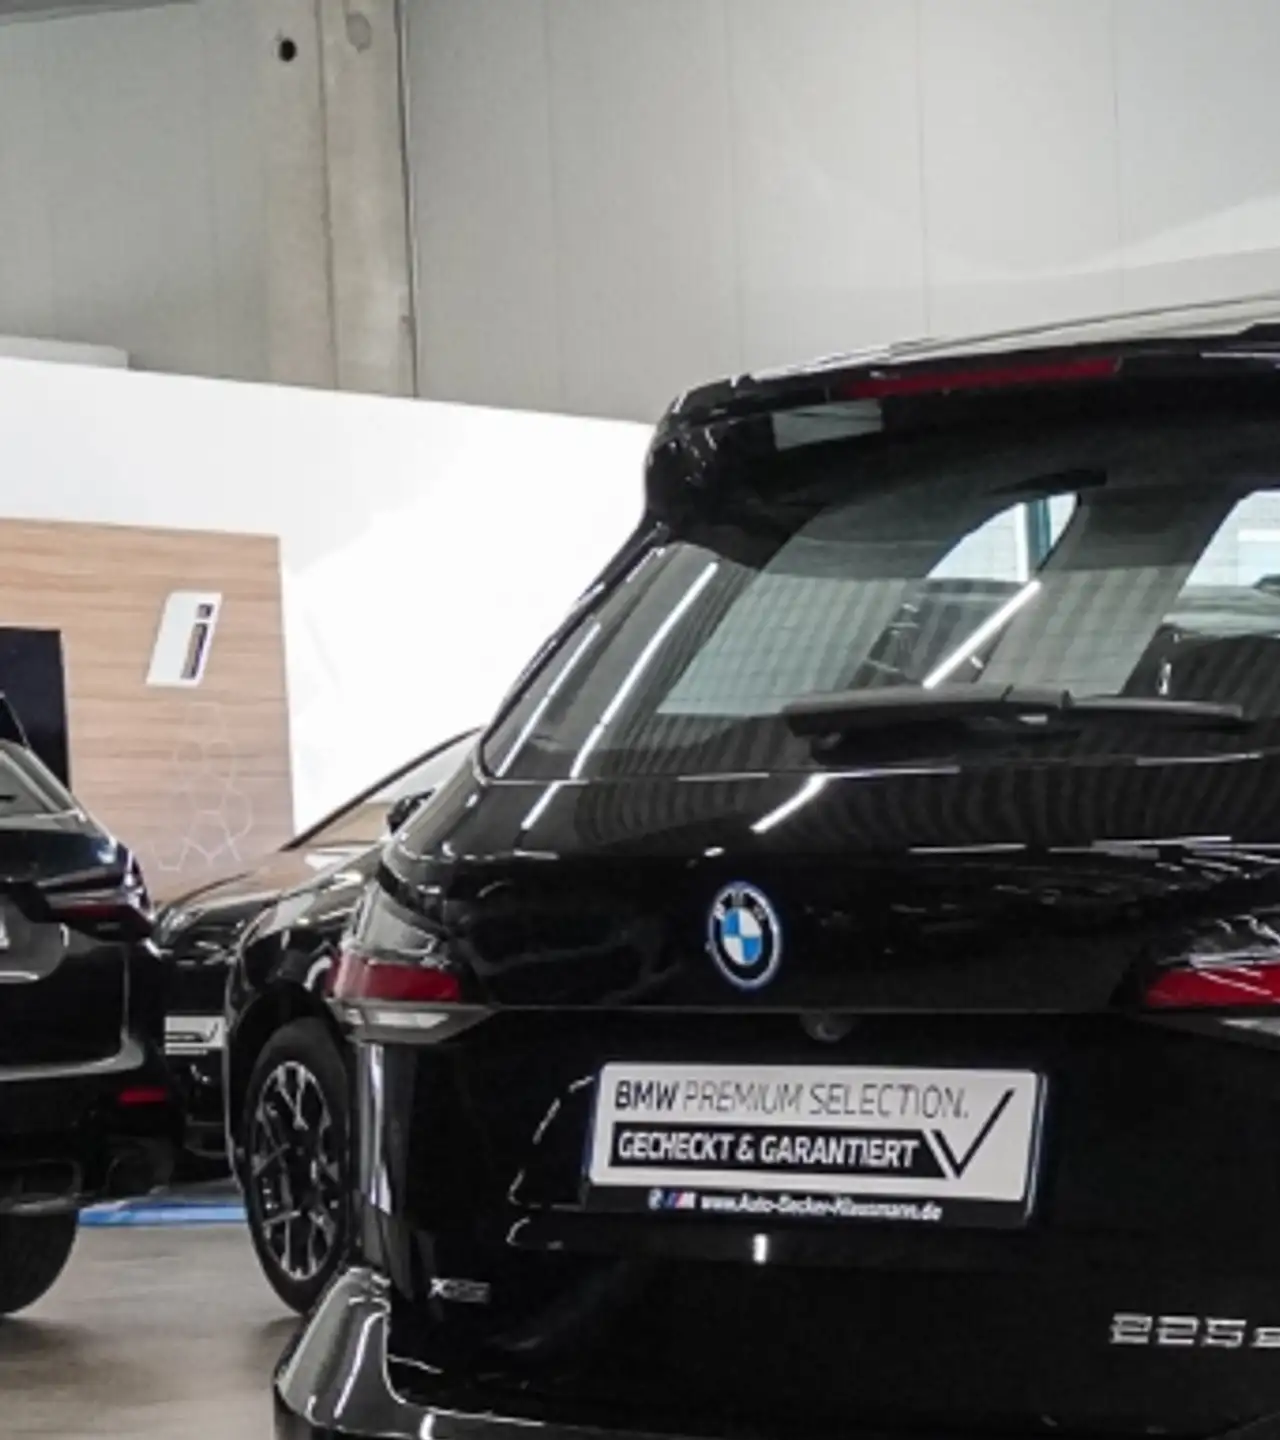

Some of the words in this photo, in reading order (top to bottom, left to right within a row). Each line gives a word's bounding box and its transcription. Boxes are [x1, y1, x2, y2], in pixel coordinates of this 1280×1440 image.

[615, 1079, 678, 1111] BMW
[684, 1080, 803, 1114] PREMIUM
[809, 1083, 969, 1119] SELECTION.
[619, 1132, 736, 1160] GECHECKT
[736, 1134, 754, 1161] &
[760, 1136, 920, 1168] GARANTIERT
